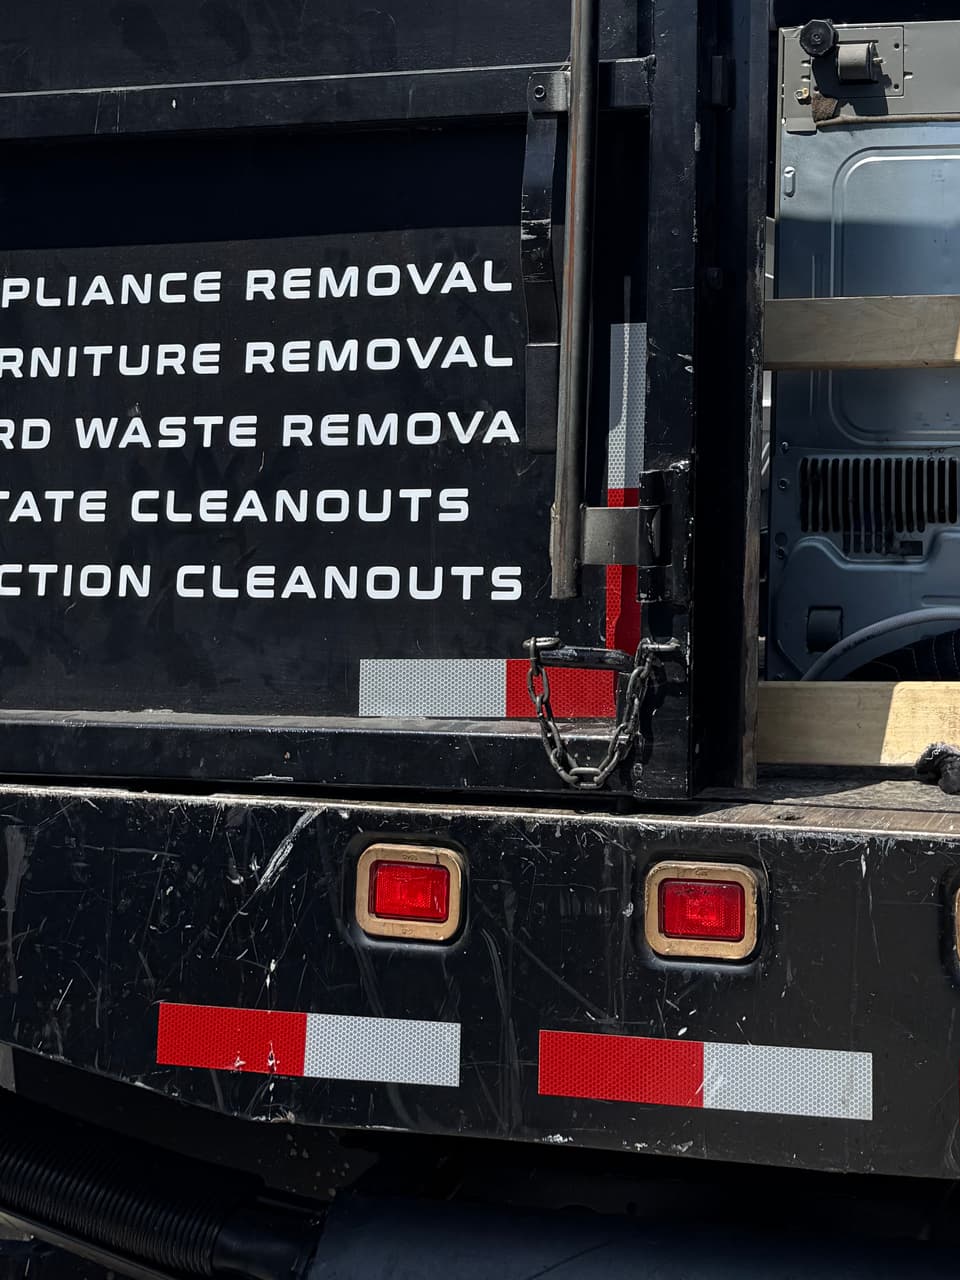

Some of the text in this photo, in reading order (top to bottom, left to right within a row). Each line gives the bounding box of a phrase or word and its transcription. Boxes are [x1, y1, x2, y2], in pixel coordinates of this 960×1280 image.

[2, 261, 512, 308] PLIANCE REMOVAL
[0, 335, 512, 379] RNITURE REMOVAL
[76, 416, 257, 448] WASTE
[283, 411, 519, 446] REMOVA
[132, 489, 469, 522] CLEANOUTS
[0, 564, 522, 600] CTION CLEANOUTS
